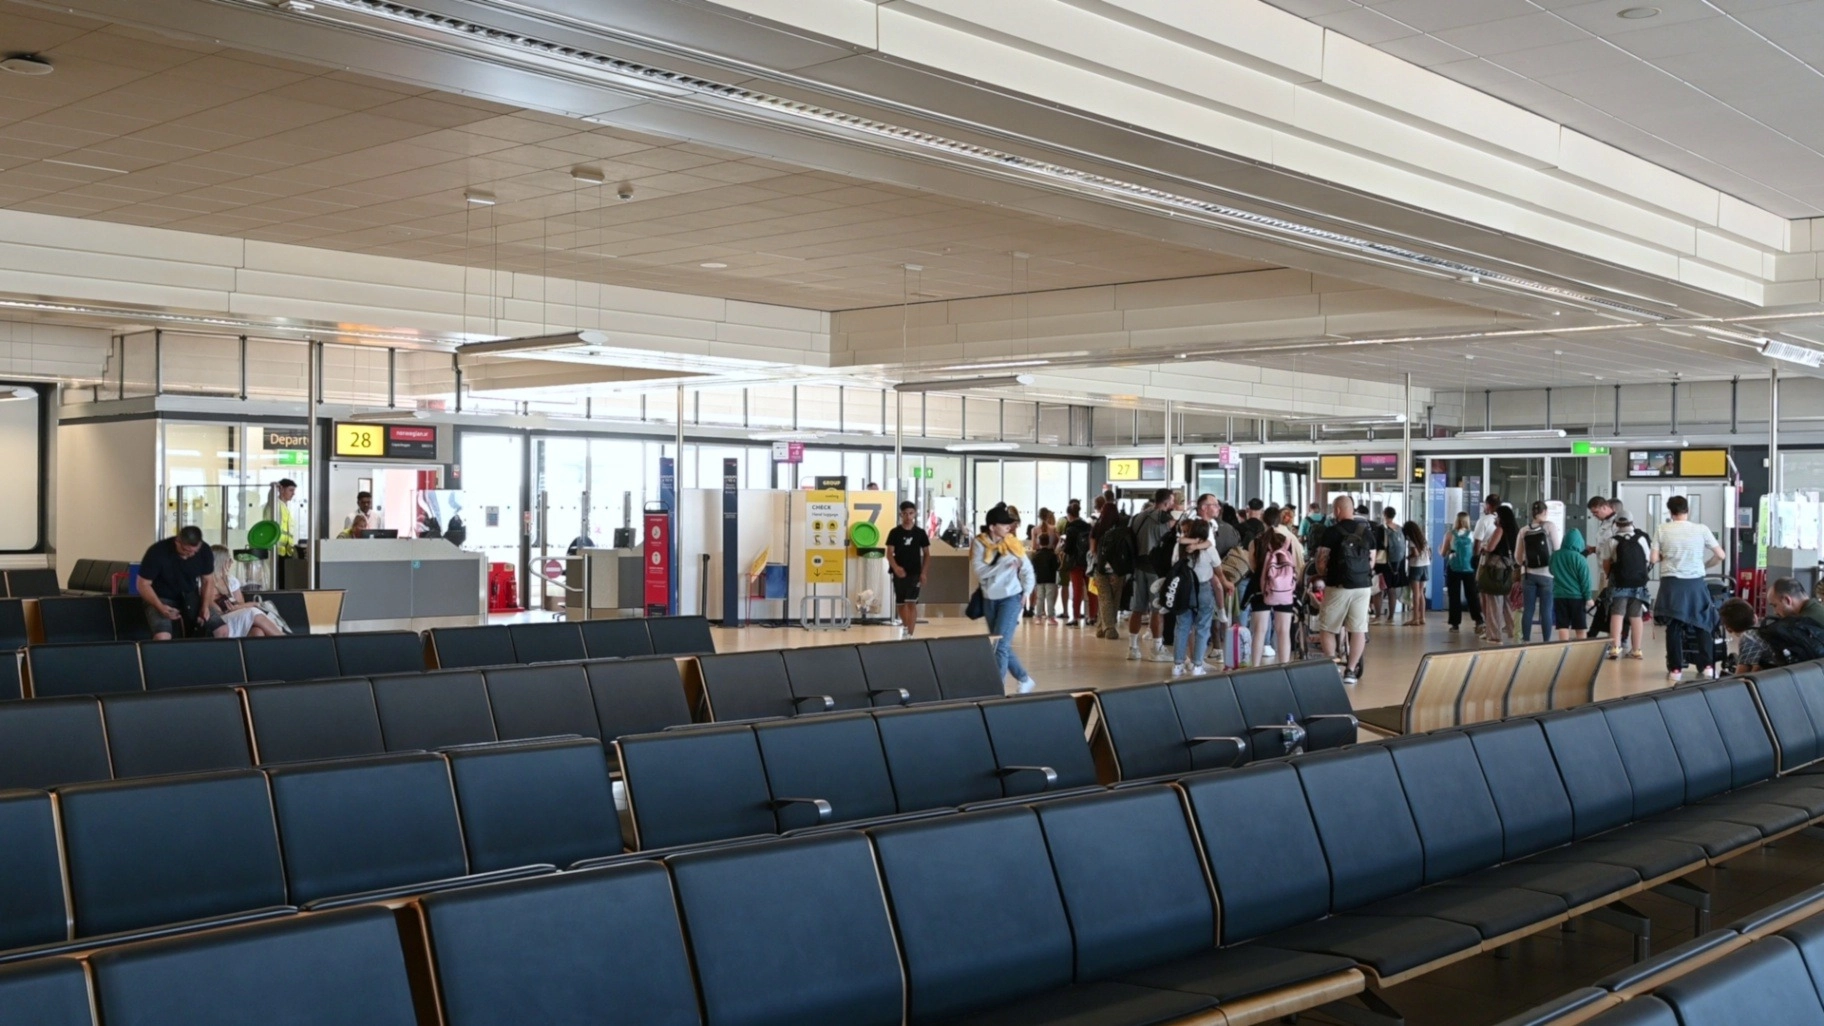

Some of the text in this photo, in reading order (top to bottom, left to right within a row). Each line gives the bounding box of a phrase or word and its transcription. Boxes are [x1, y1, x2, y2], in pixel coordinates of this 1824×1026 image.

[270, 433, 309, 447] Depart
[350, 432, 371, 448] 28
[1117, 464, 1130, 475] 27
[853, 503, 882, 524] 7
[1165, 576, 1180, 608] adidas
